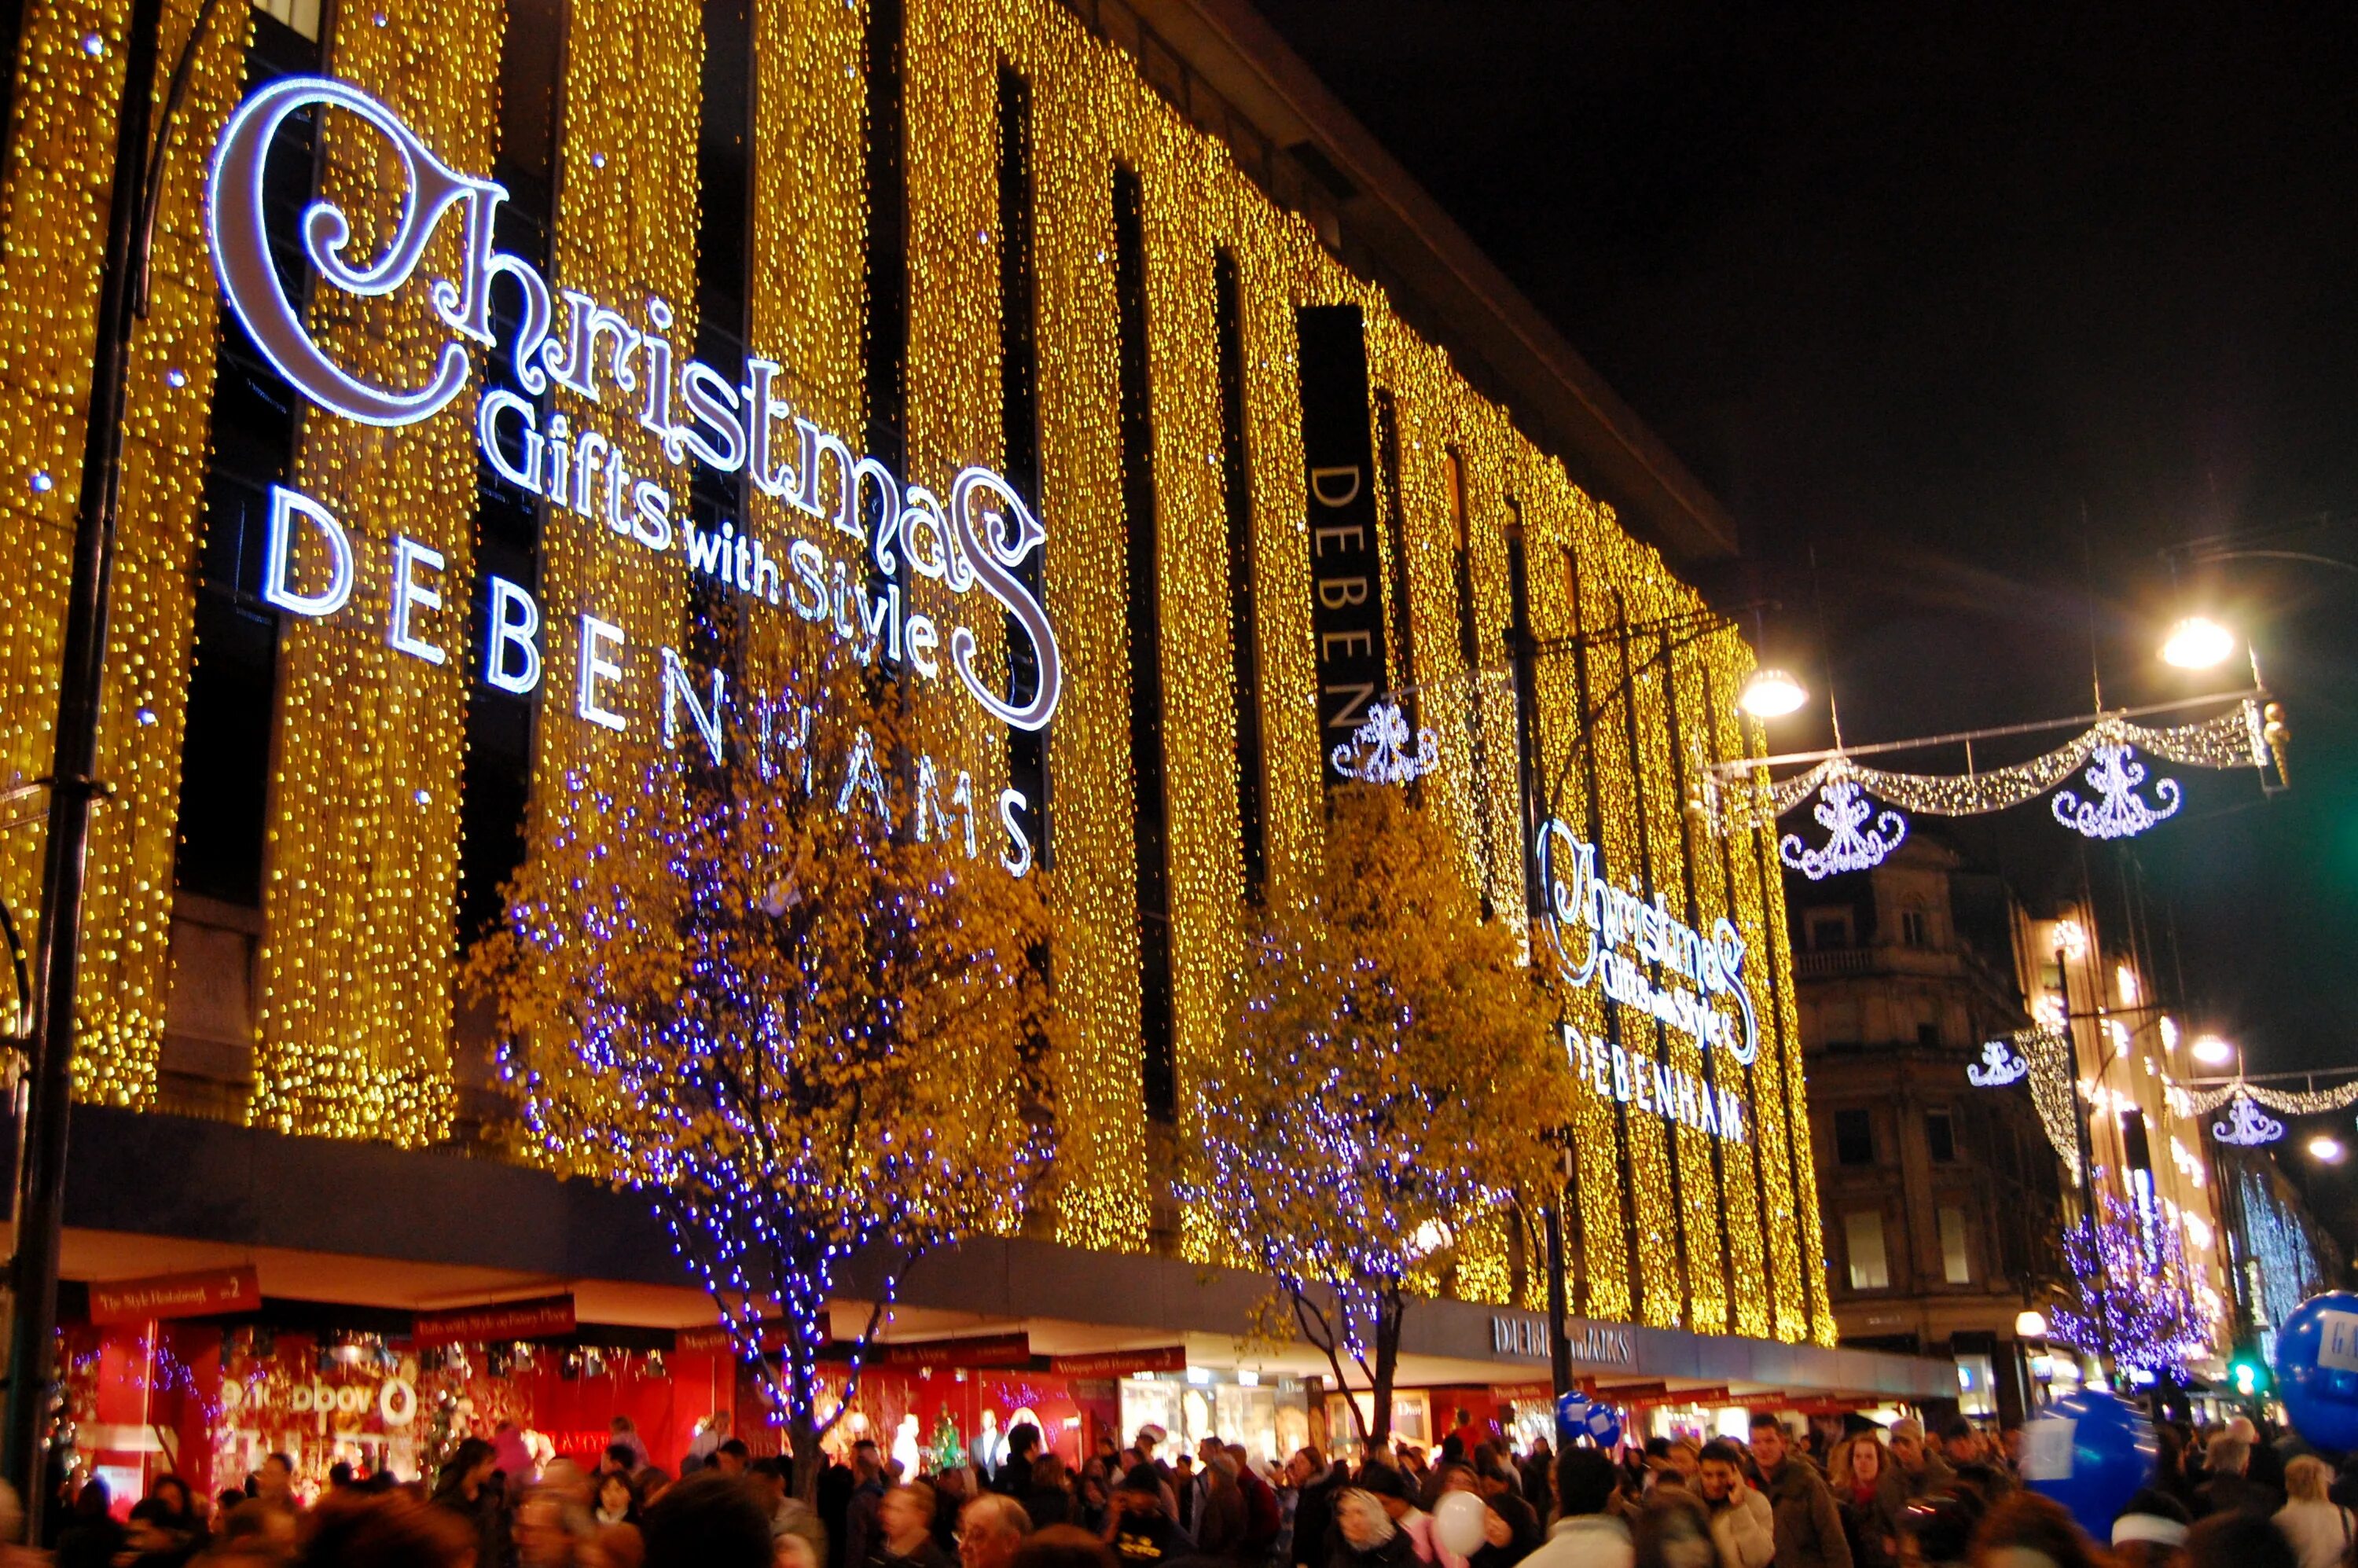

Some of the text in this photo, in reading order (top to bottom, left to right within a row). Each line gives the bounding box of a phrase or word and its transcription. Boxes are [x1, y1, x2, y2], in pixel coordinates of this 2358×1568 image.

[263, 482, 1034, 878] DEBENHAMS
[479, 387, 939, 680] Gifts with Style
